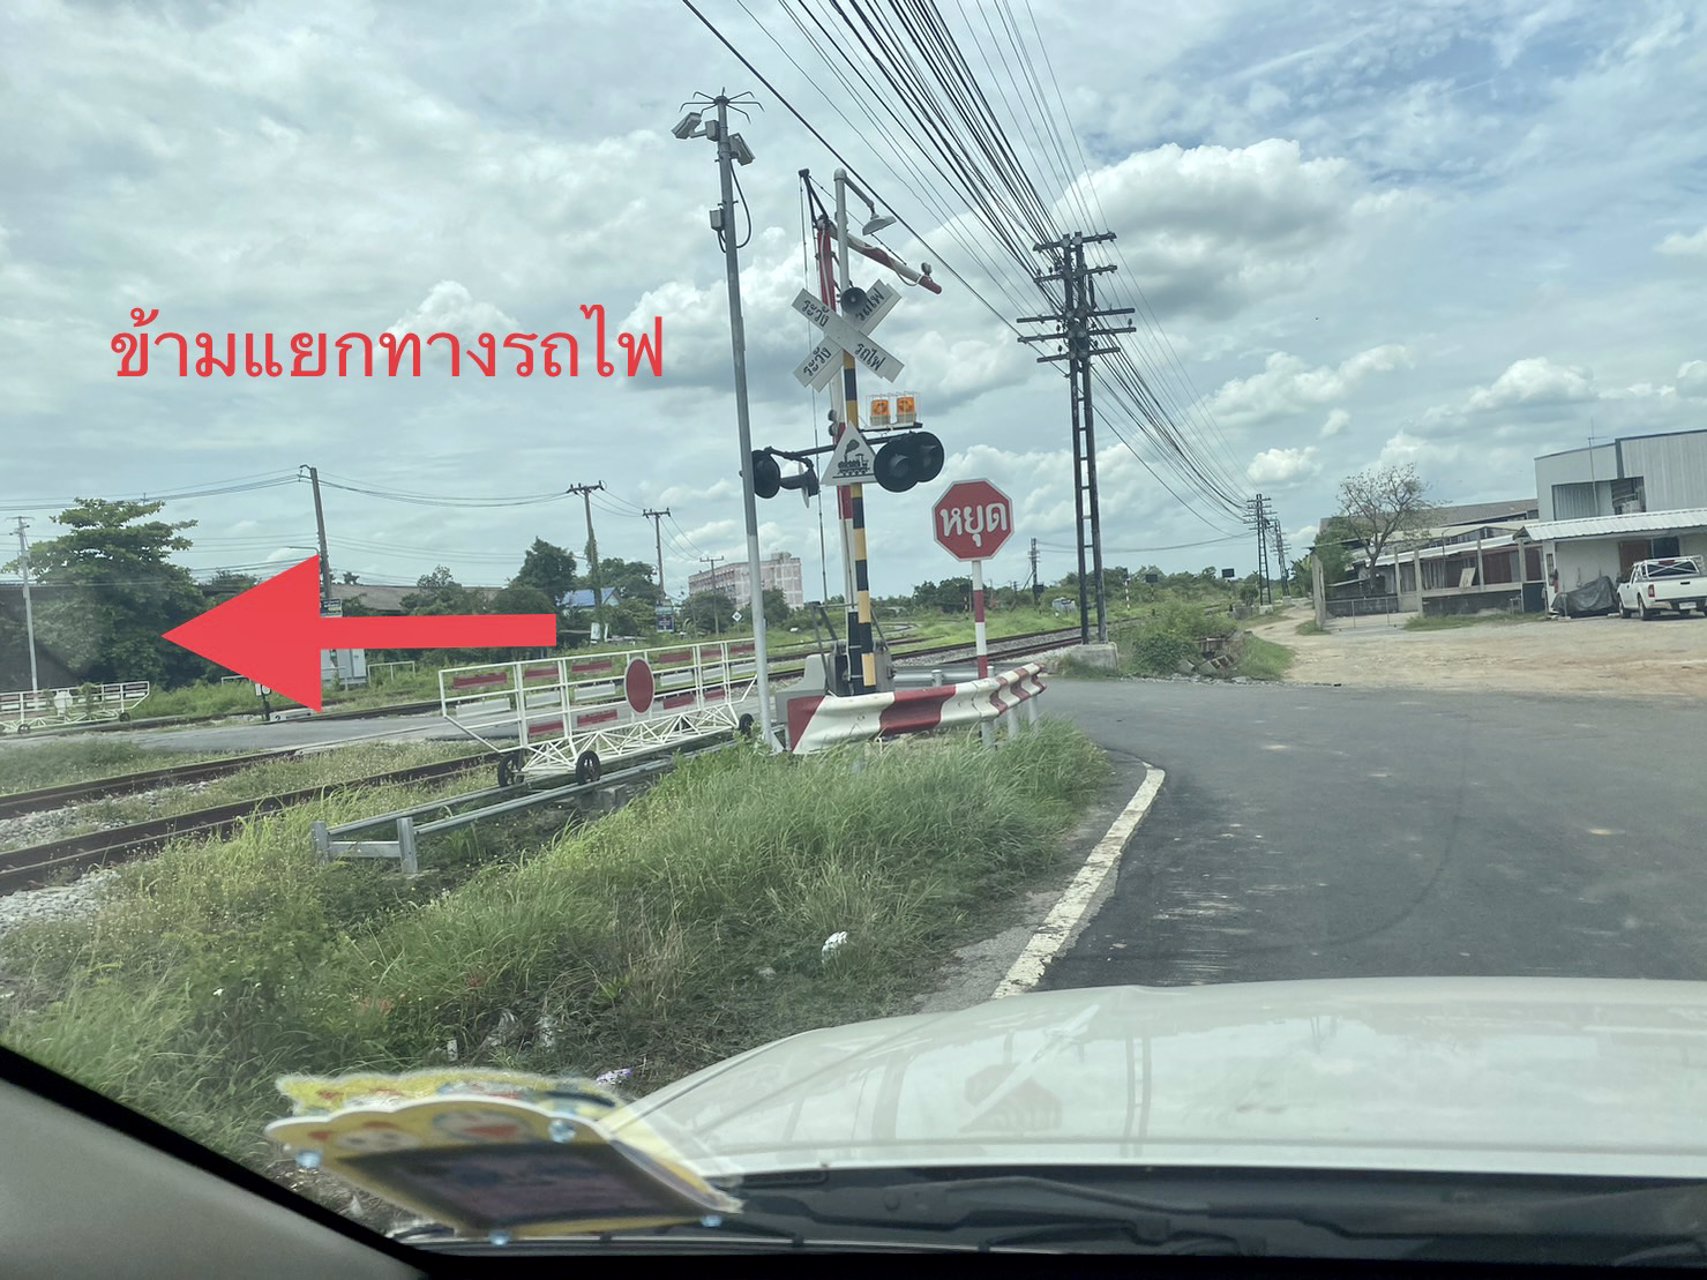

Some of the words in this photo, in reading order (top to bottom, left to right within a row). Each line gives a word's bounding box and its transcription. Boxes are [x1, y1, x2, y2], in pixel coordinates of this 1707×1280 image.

[802, 300, 830, 327] ระวัง
[855, 343, 887, 371] รถไฟ
[803, 346, 832, 376] ระวัง
[940, 503, 1007, 547] หยุด
